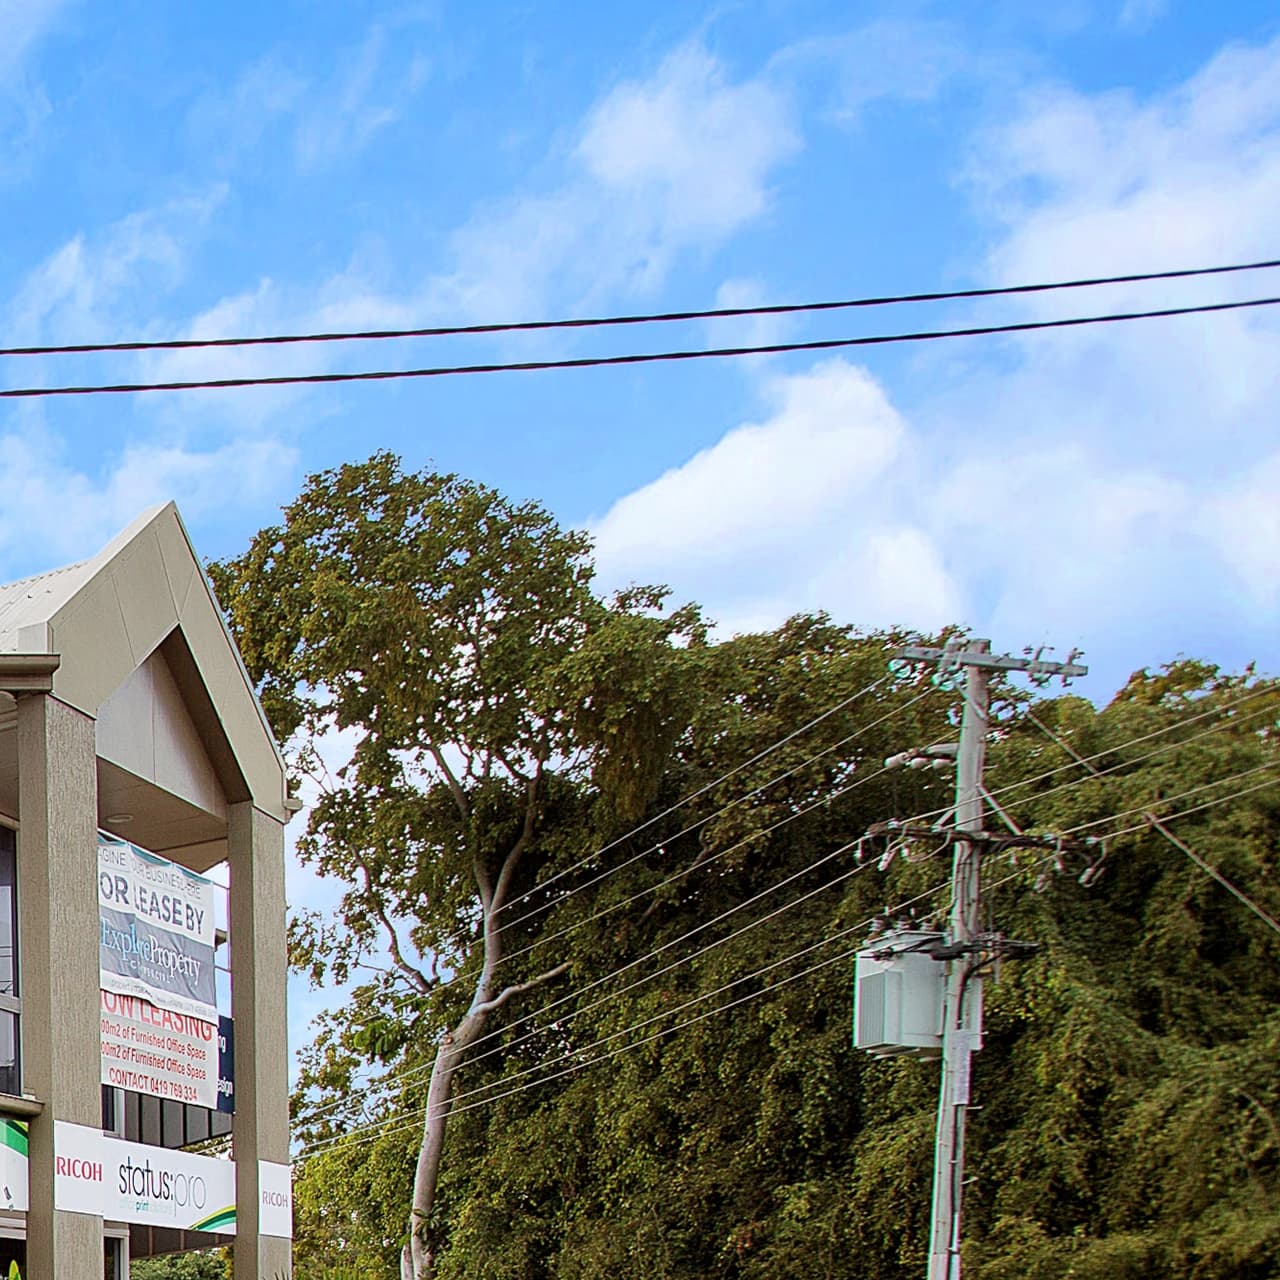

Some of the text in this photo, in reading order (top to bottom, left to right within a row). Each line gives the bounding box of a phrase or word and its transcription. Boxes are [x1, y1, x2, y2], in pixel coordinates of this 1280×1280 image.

[100, 871, 130, 905] OR
[185, 902, 205, 935] BY
[139, 998, 213, 1042] LEASING
[122, 1026, 131, 1040] of
[131, 1027, 165, 1049] Furnished
[166, 1037, 186, 1055] Office
[186, 1043, 206, 1060] Space
[109, 1067, 149, 1090] CONTACT
[122, 1046, 131, 1060] of
[131, 1047, 165, 1070] Furnished
[166, 1058, 186, 1075] Office
[186, 1063, 206, 1080] Space
[56, 1156, 102, 1182] RICOH
[262, 1190, 288, 1208] RICOH
